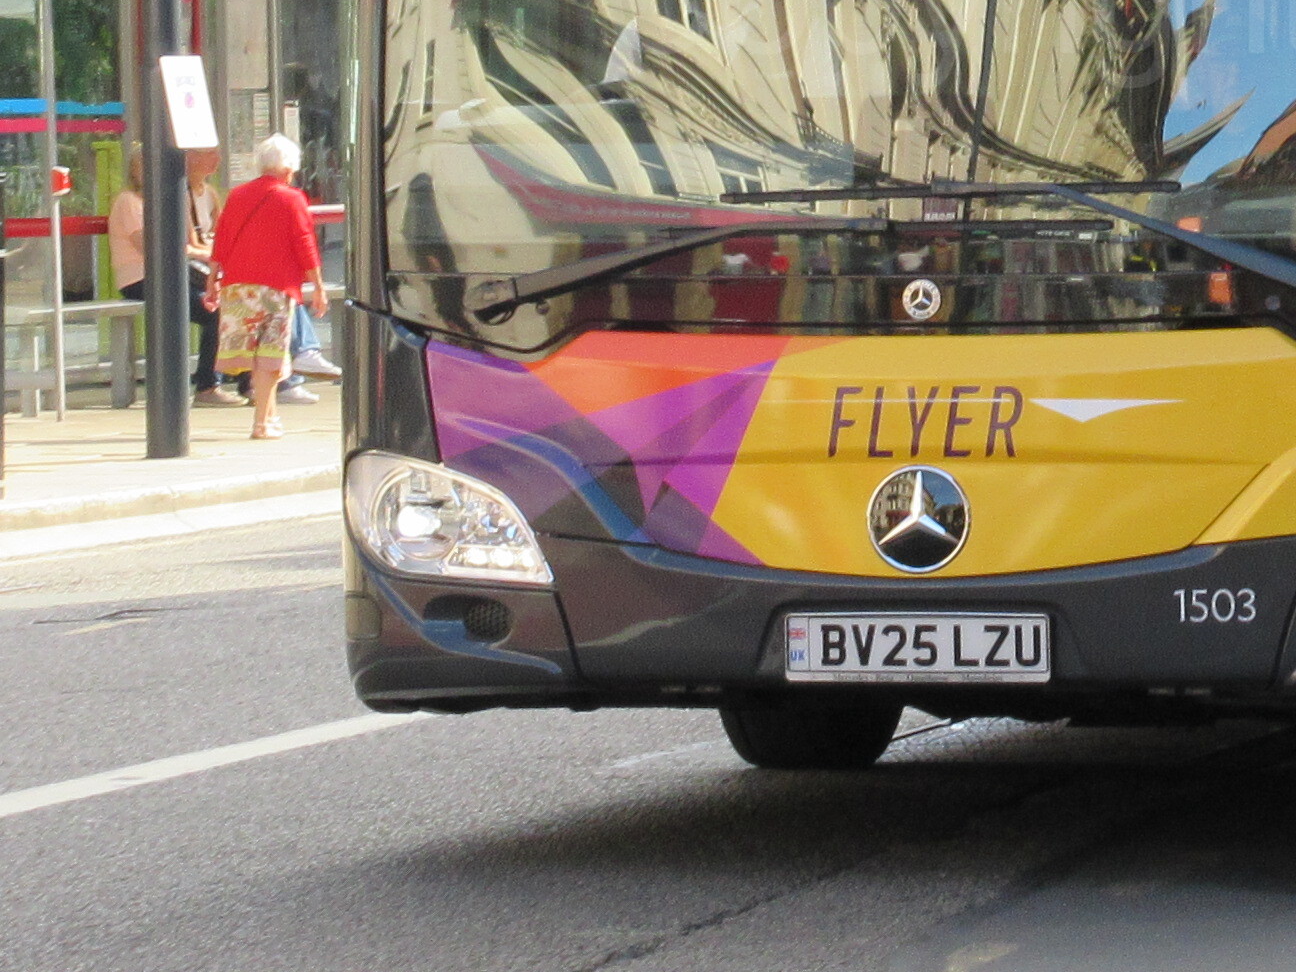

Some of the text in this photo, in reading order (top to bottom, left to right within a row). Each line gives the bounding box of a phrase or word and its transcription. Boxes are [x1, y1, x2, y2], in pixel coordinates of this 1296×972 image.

[827, 385, 1024, 458] FLYER
[1172, 588, 1256, 623] 1503
[820, 623, 1042, 666] BV25 LZU
